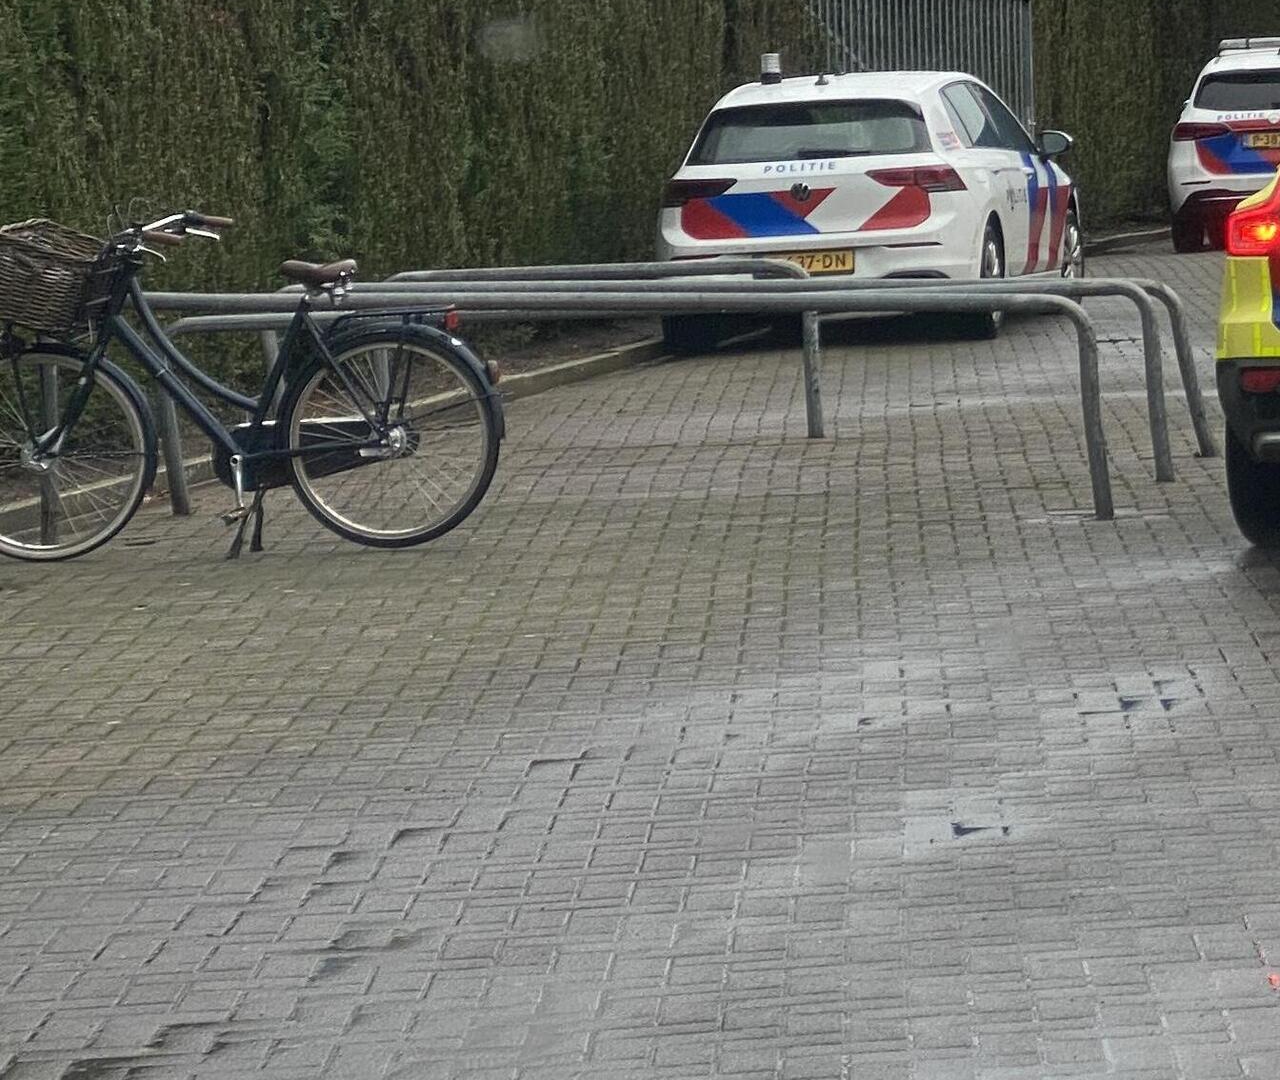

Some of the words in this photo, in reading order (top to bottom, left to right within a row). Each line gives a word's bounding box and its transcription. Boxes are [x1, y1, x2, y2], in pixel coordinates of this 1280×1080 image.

[1217, 112, 1265, 121] POLITIE
[763, 162, 836, 174] POLITIE
[786, 253, 847, 270] 37-DN
